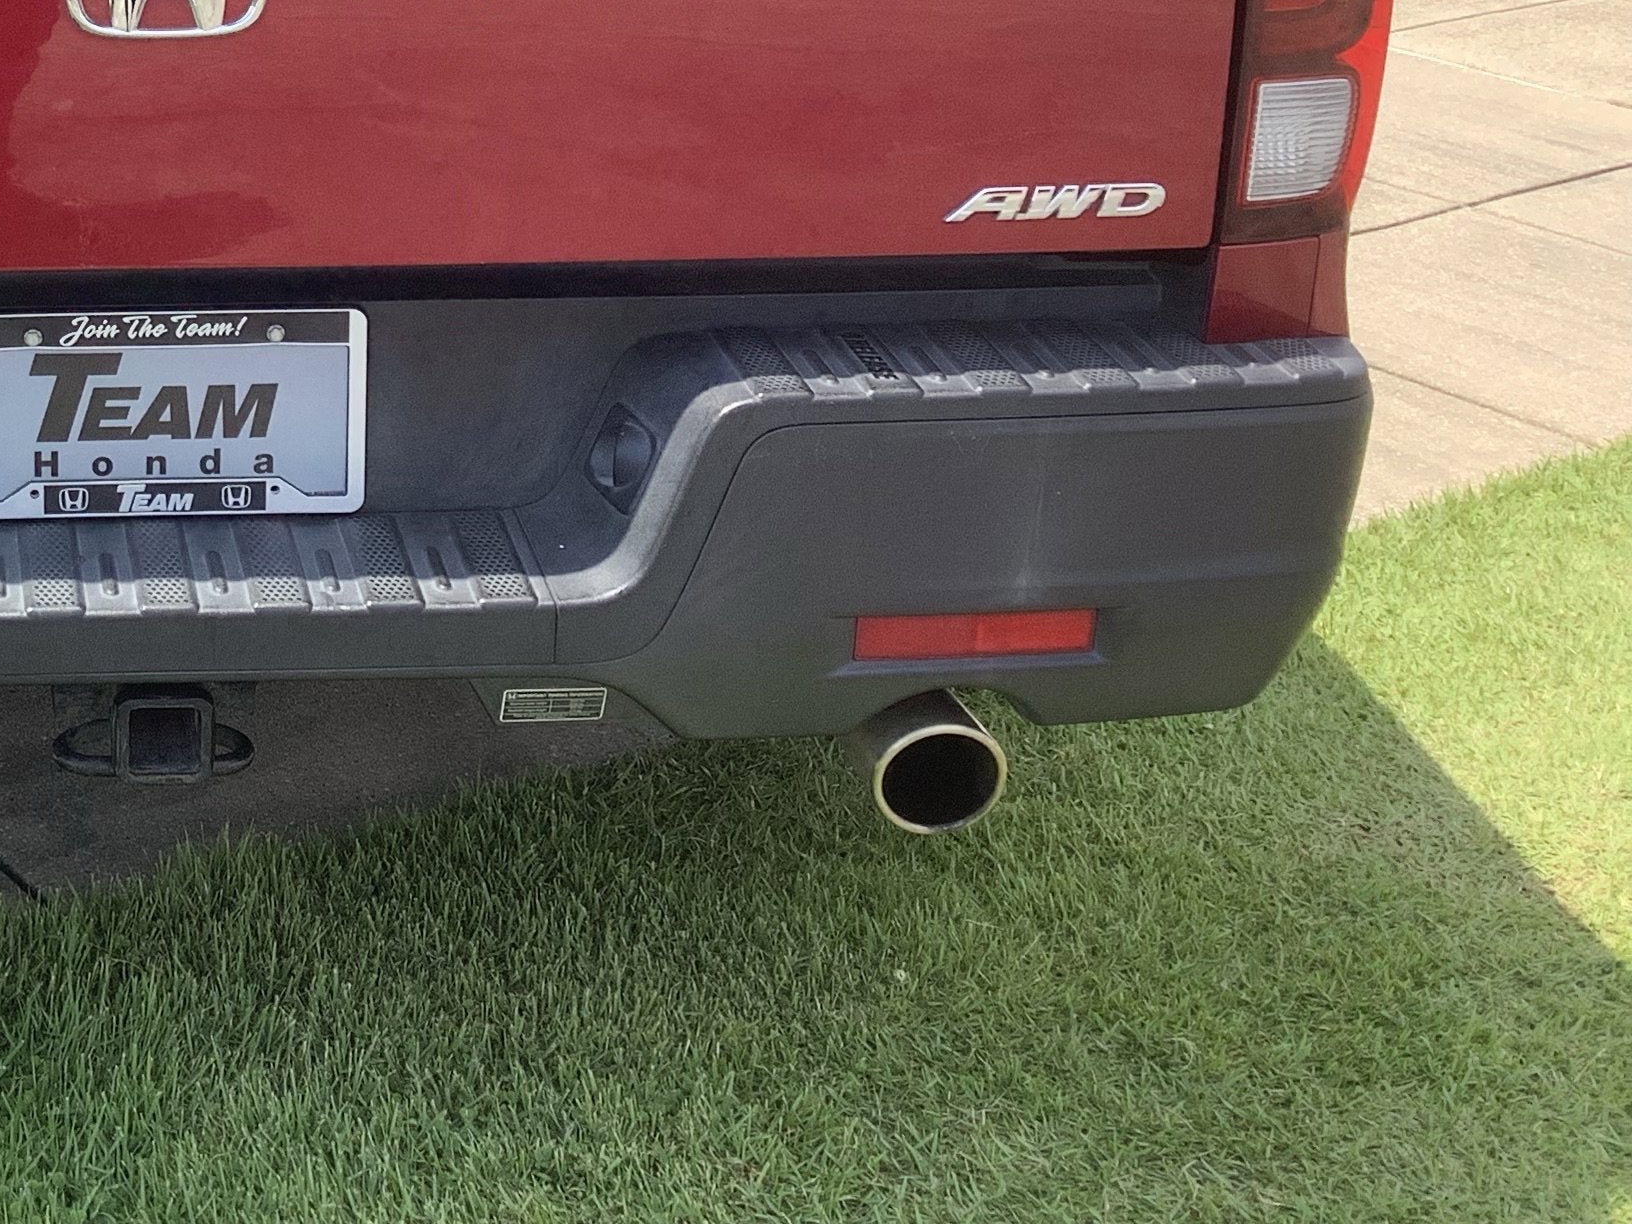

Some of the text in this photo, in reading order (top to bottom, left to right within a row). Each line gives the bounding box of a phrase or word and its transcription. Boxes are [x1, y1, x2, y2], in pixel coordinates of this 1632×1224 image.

[942, 181, 1167, 223] AWD
[59, 314, 248, 348] Join The Team!
[28, 351, 280, 443] TEAM
[33, 447, 275, 478] Honda
[116, 483, 195, 513] TEAM
